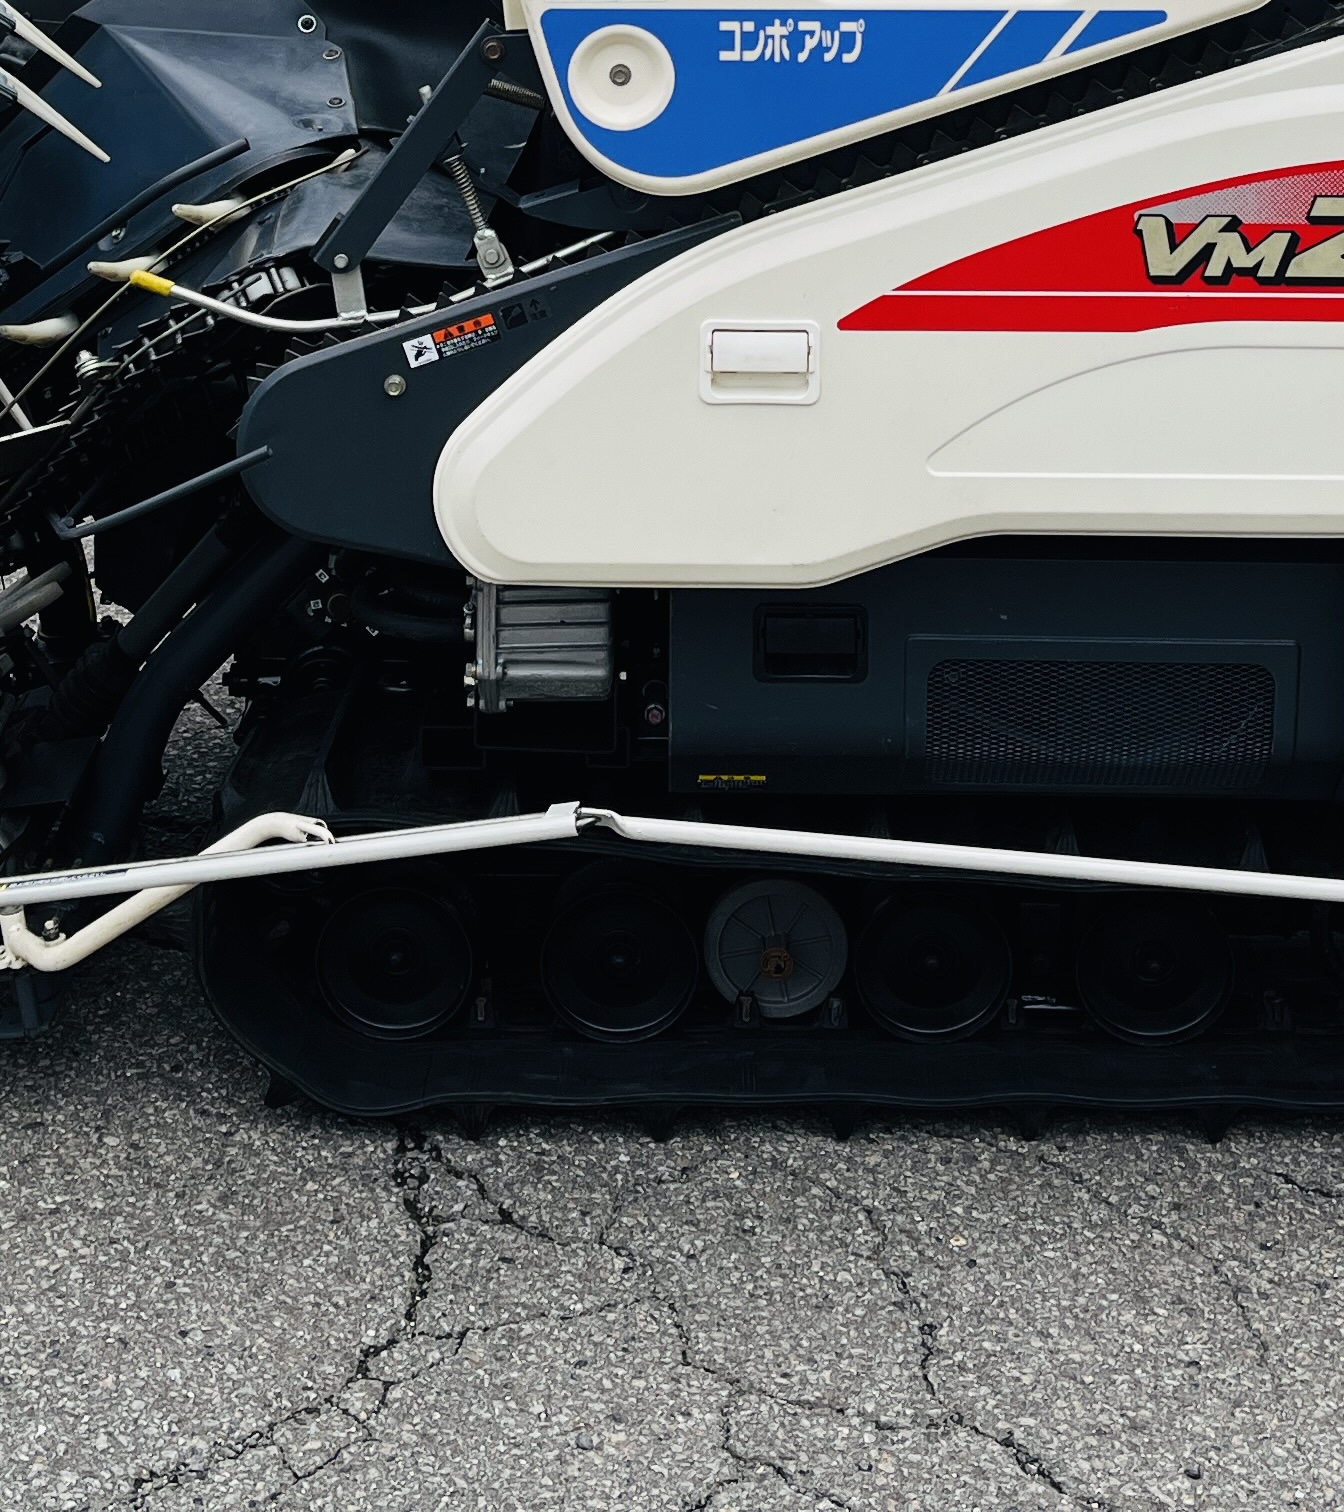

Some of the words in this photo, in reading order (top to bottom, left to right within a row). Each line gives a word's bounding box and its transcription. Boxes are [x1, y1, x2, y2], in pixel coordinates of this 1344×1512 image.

[718, 18, 866, 64] コンポアップ
